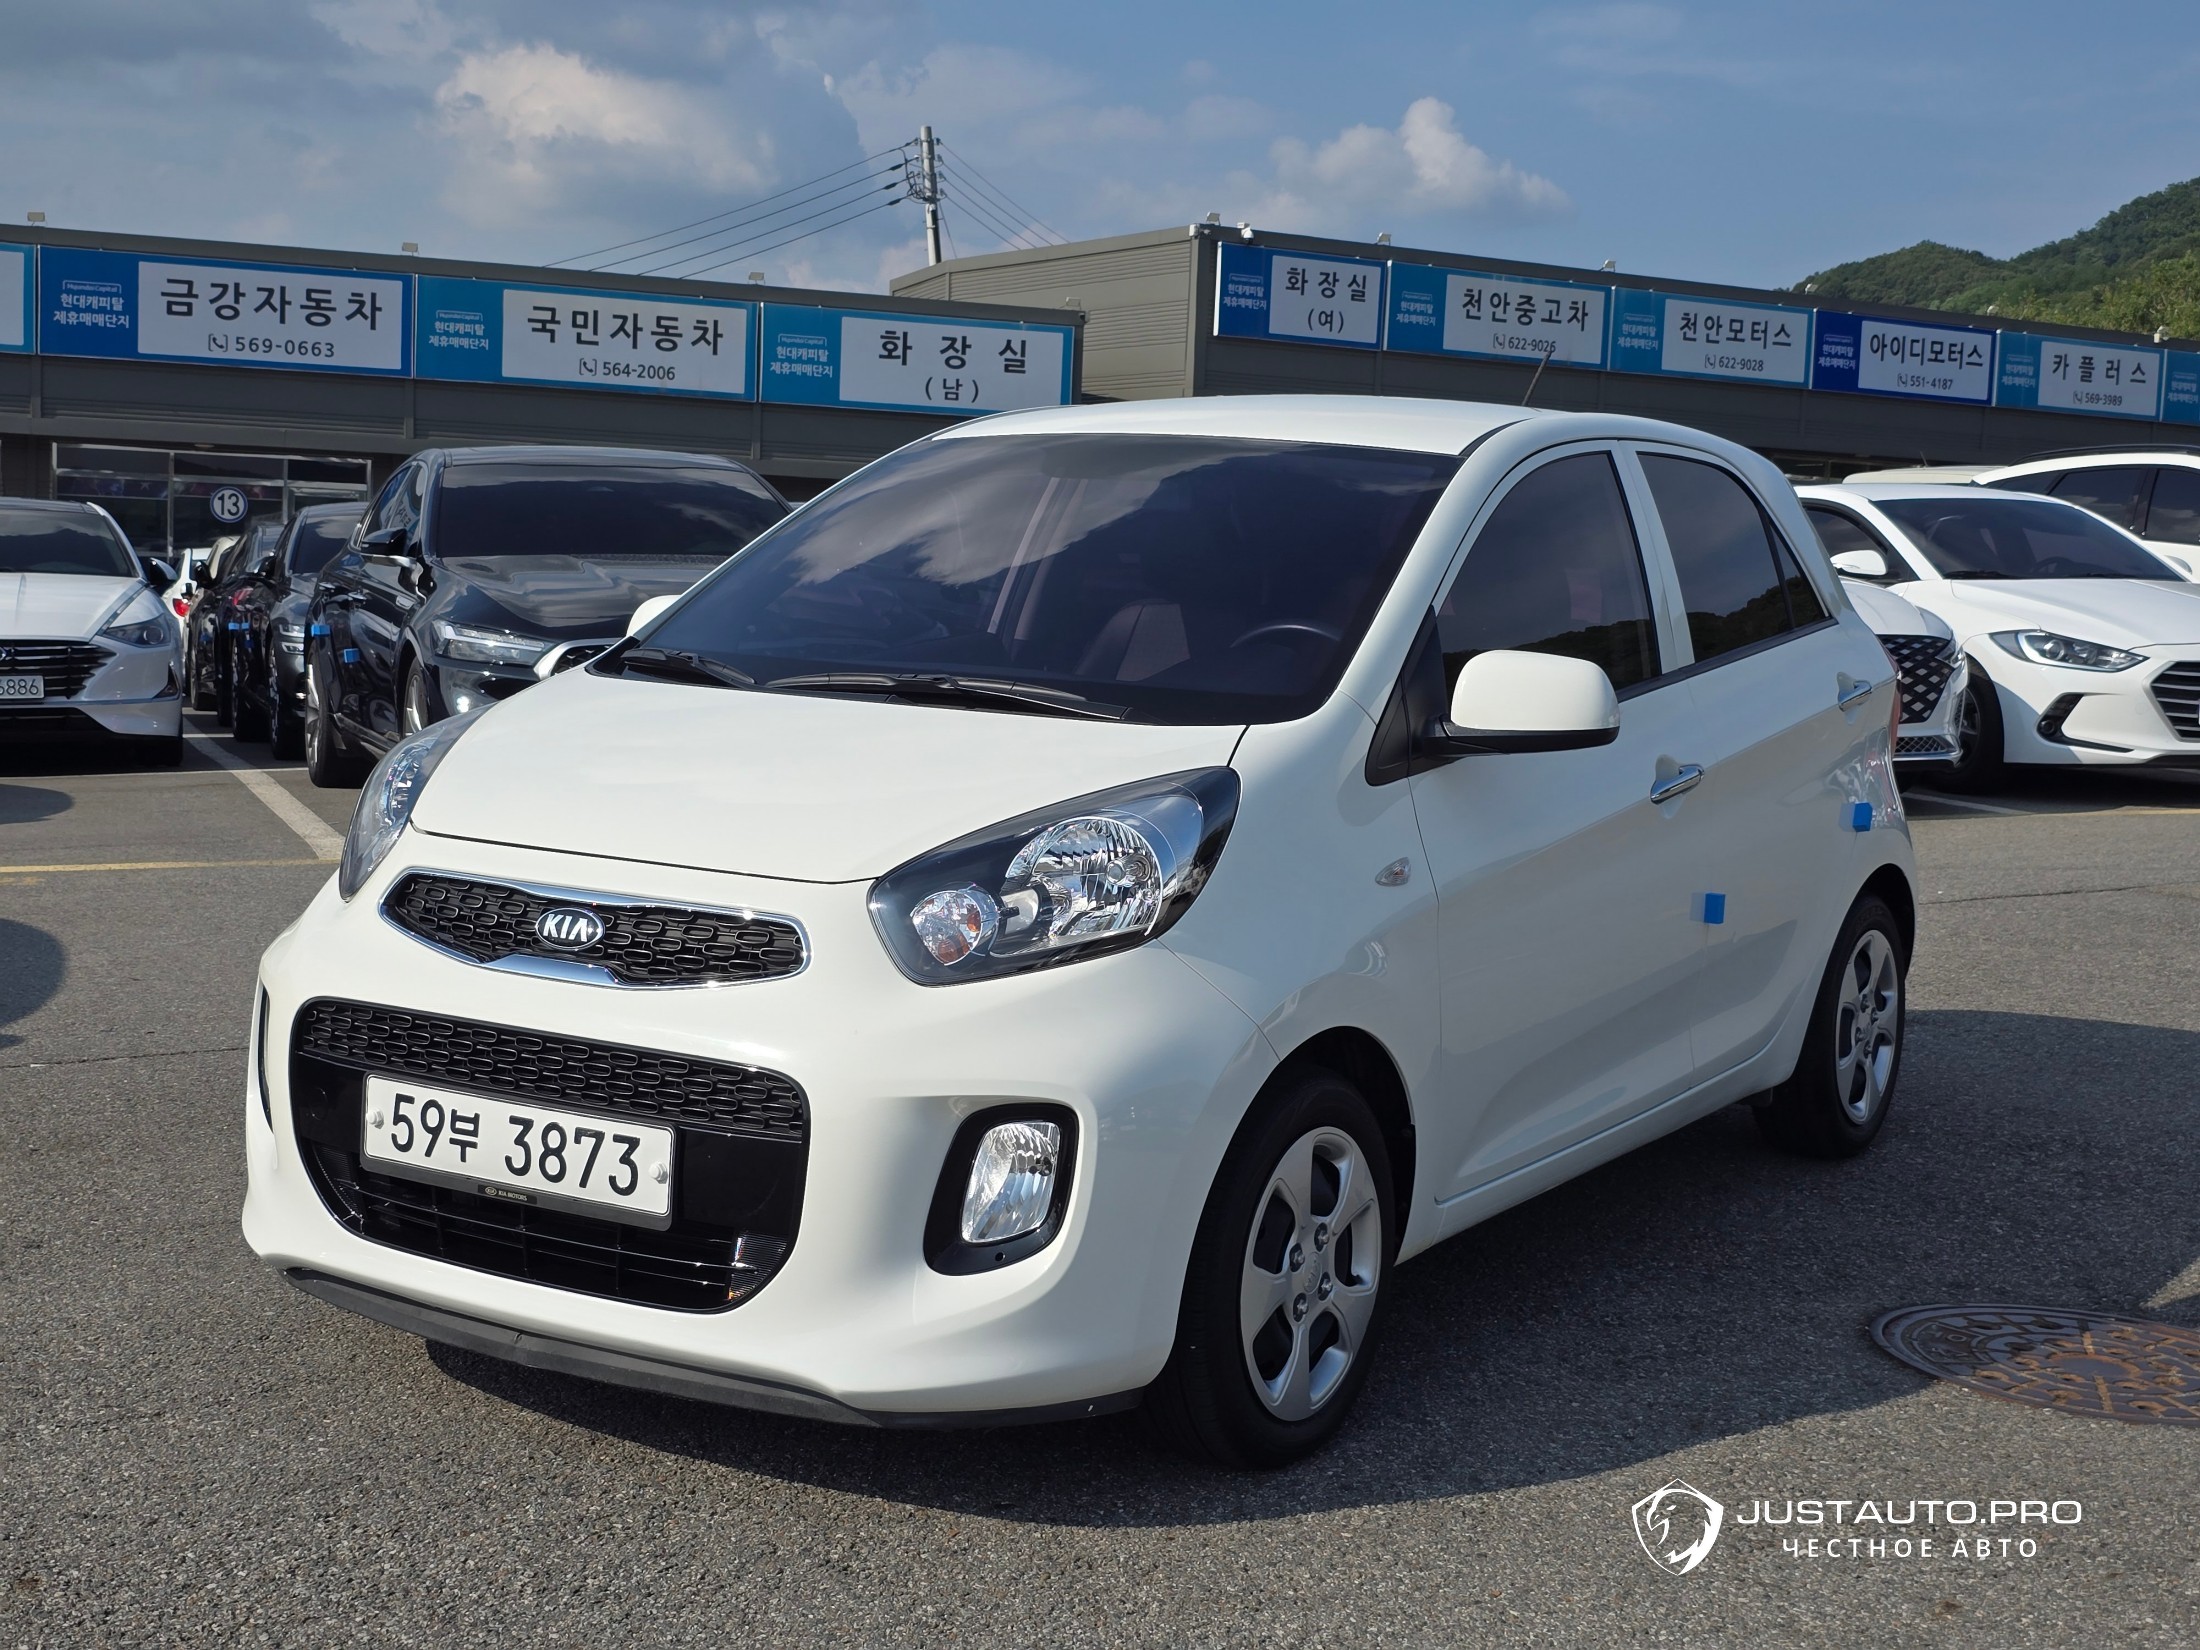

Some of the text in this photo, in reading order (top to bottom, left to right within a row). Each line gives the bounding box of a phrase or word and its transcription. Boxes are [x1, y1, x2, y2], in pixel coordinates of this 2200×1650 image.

[60, 293, 124, 311] 현대캐피탈
[161, 278, 383, 330] 금강자동차
[1462, 289, 1588, 331] 천안중고차
[53, 310, 129, 328] 제휴매매단지
[434, 321, 485, 336] 현대캐피탈
[527, 305, 723, 355] 국민자동차
[1679, 312, 1791, 350] 천안모터스
[235, 336, 335, 358] 569-0663
[428, 336, 488, 350] 제휴매매단지
[1508, 336, 1556, 353] 622-9026
[1870, 332, 1983, 370] 아이디모터스
[776, 346, 829, 362] 현대캐피탈
[602, 361, 675, 380] 564-2006
[770, 362, 832, 378] 제휴매매단지
[1718, 356, 1764, 372] 622-9028
[1910, 376, 1953, 390] 551-4187
[2085, 392, 2122, 406] 569-3989
[217, 493, 240, 516] 13
[543, 914, 588, 942] KIA
[391, 1093, 641, 1196] 59부 3873
